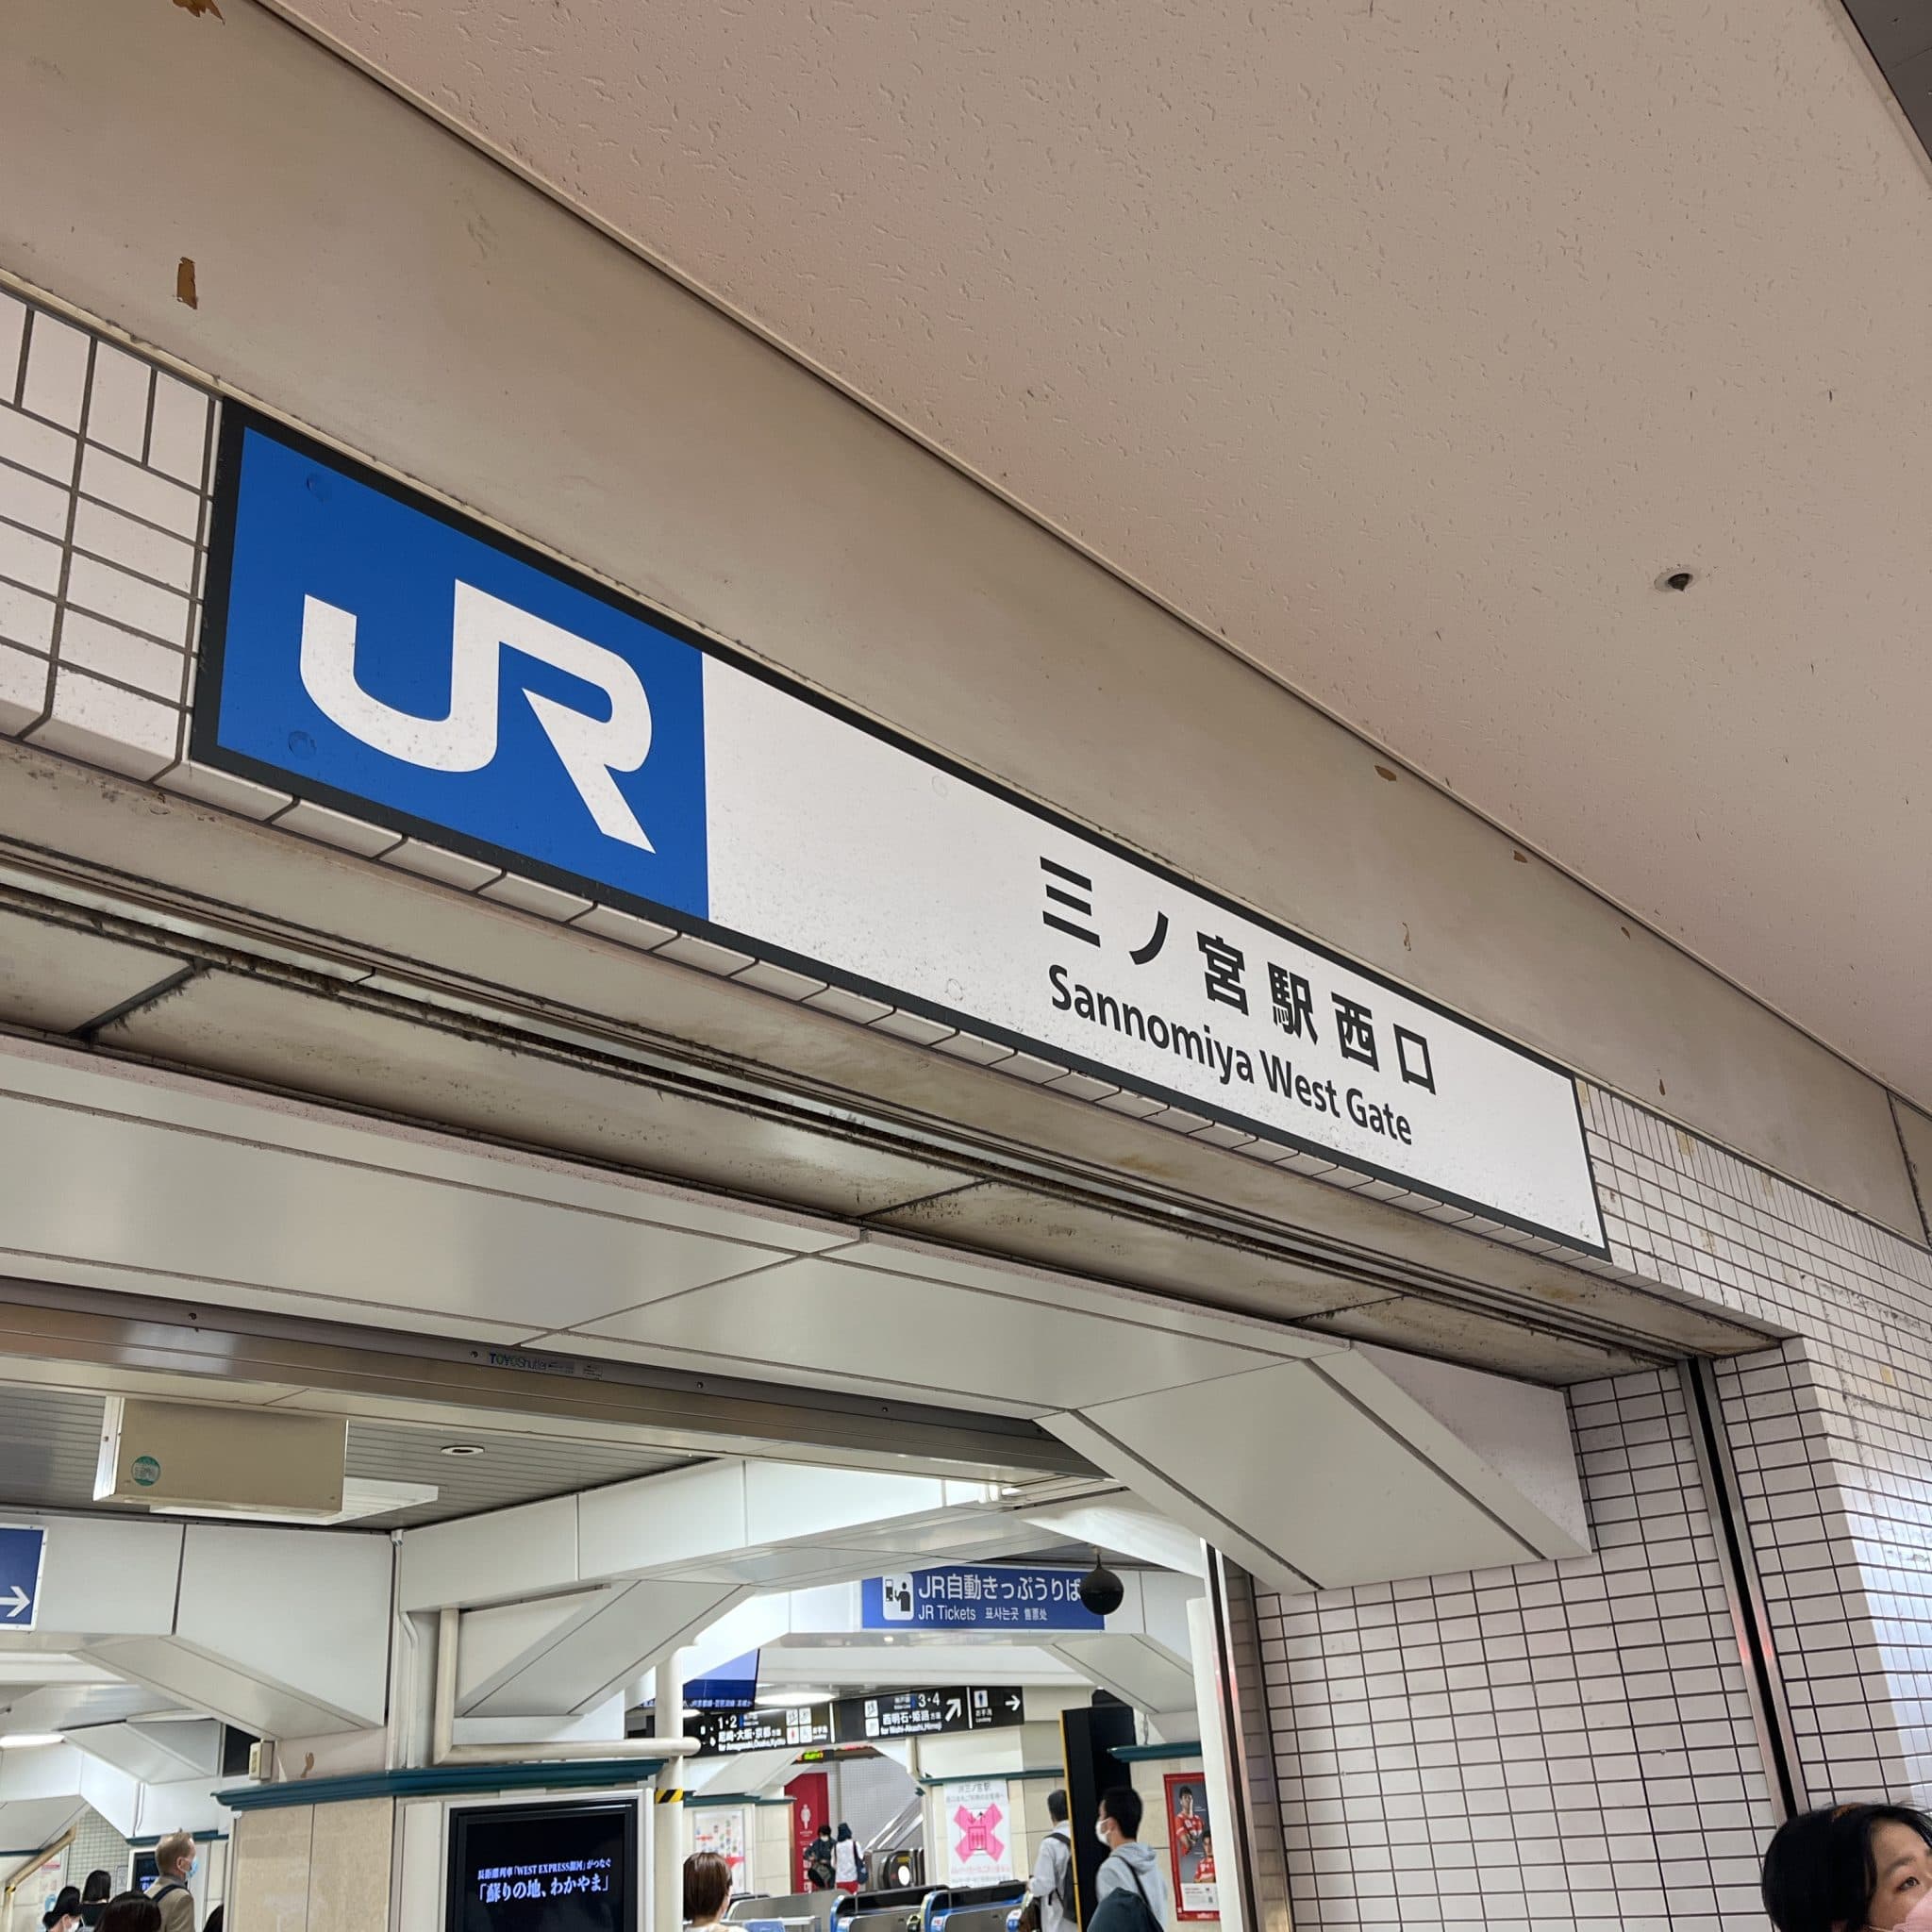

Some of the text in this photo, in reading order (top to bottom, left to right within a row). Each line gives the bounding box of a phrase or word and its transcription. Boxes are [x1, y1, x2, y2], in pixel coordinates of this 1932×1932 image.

[300, 578, 656, 854] JR
[1040, 857, 1436, 1095] 三ノ宮駅西口
[1048, 964, 1413, 1146] Sannomiya West Gate
[918, 1574, 1081, 1602] JR自動きっぷうりば
[918, 1605, 976, 1621] JR Tickets
